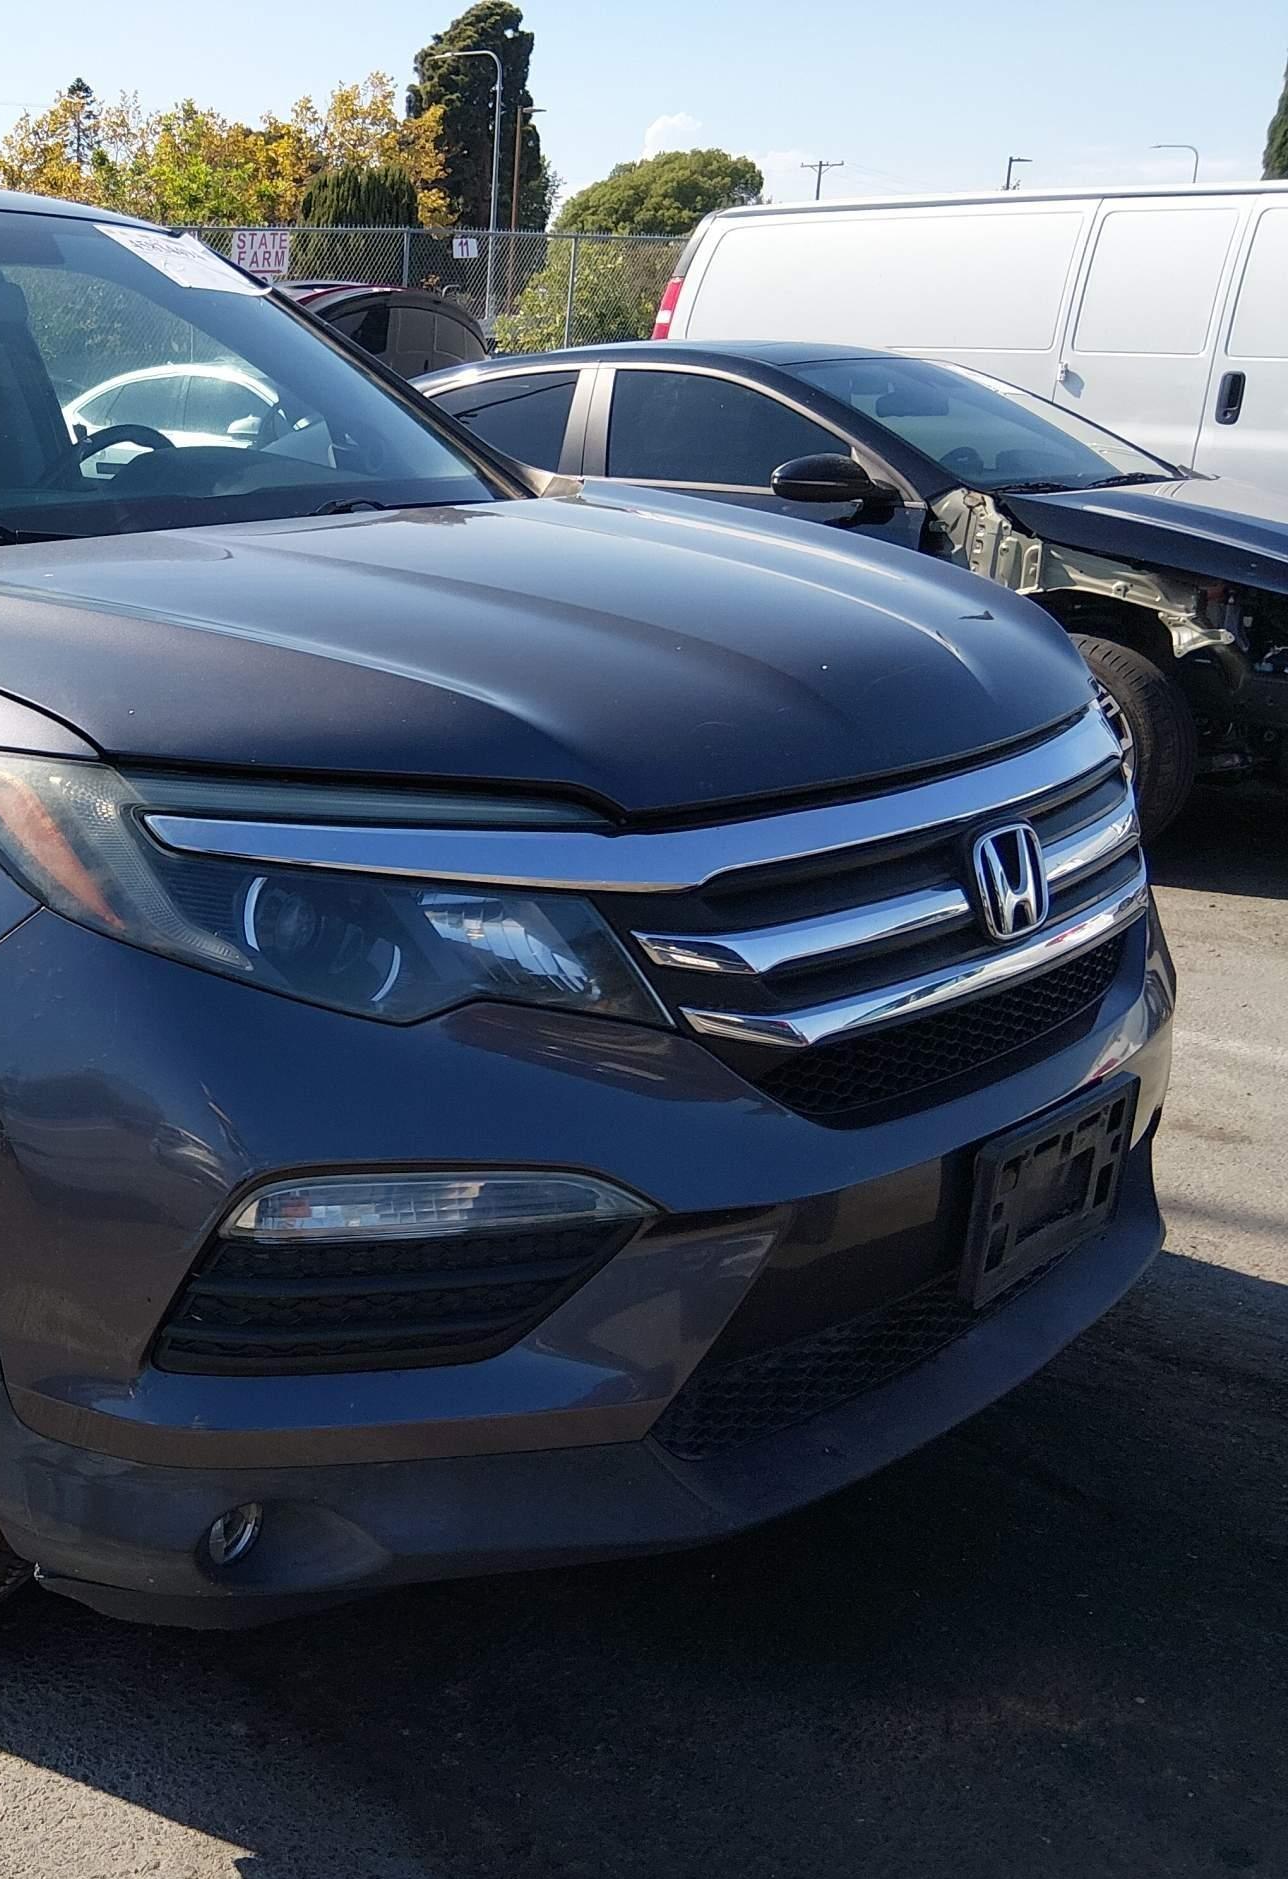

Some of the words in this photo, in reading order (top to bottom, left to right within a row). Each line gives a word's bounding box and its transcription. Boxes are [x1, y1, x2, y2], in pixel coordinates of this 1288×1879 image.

[237, 233, 288, 250] STATE
[458, 239, 469, 257] 11
[237, 250, 285, 268] FARM
